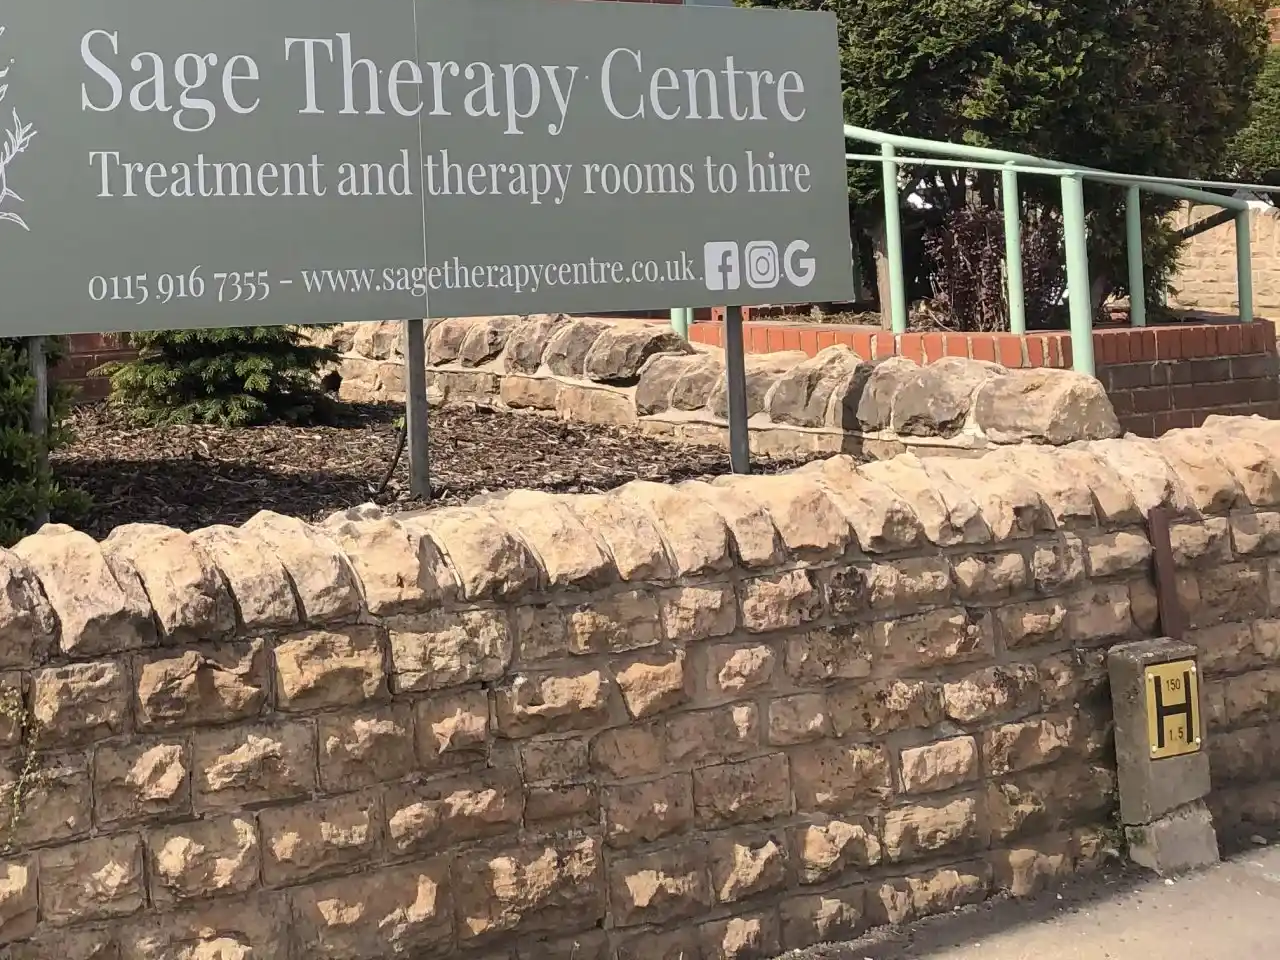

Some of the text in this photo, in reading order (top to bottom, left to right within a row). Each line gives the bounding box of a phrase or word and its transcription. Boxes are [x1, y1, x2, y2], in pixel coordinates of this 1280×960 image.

[81, 30, 806, 135] Sage Therapy Centre
[89, 149, 811, 204] Treatment and therapy rooms to hire
[88, 273, 149, 304] 0115
[158, 265, 205, 304] 916
[213, 270, 270, 302] 7355
[301, 250, 695, 296] www.sagetherapycentre.co.uk
[1154, 671, 1193, 748] H
[1166, 679, 1181, 692] 150
[1169, 727, 1184, 741] 1.5
